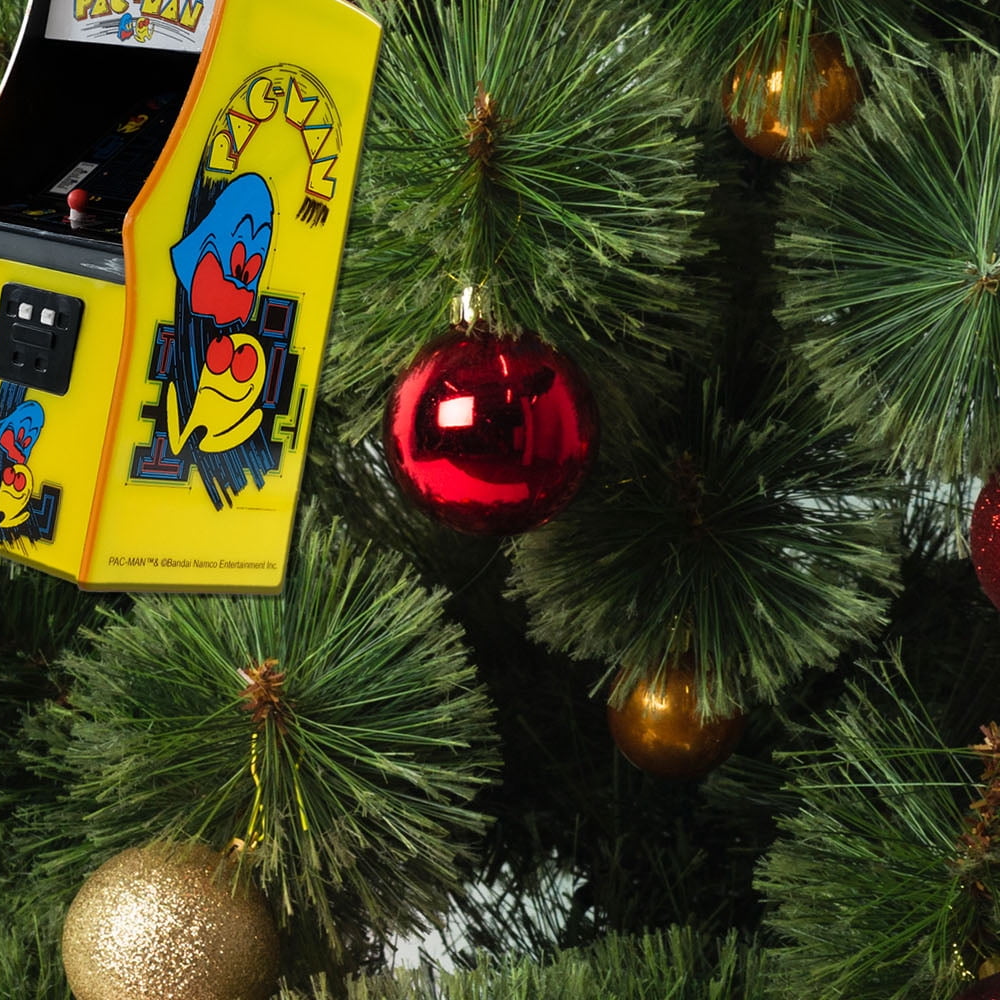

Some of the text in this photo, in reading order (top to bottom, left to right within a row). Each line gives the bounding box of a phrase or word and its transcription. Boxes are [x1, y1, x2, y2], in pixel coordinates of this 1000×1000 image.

[205, 77, 338, 201] PAC-MAN
[193, 559, 218, 569] Namco
[219, 559, 265, 569] Entertainment
